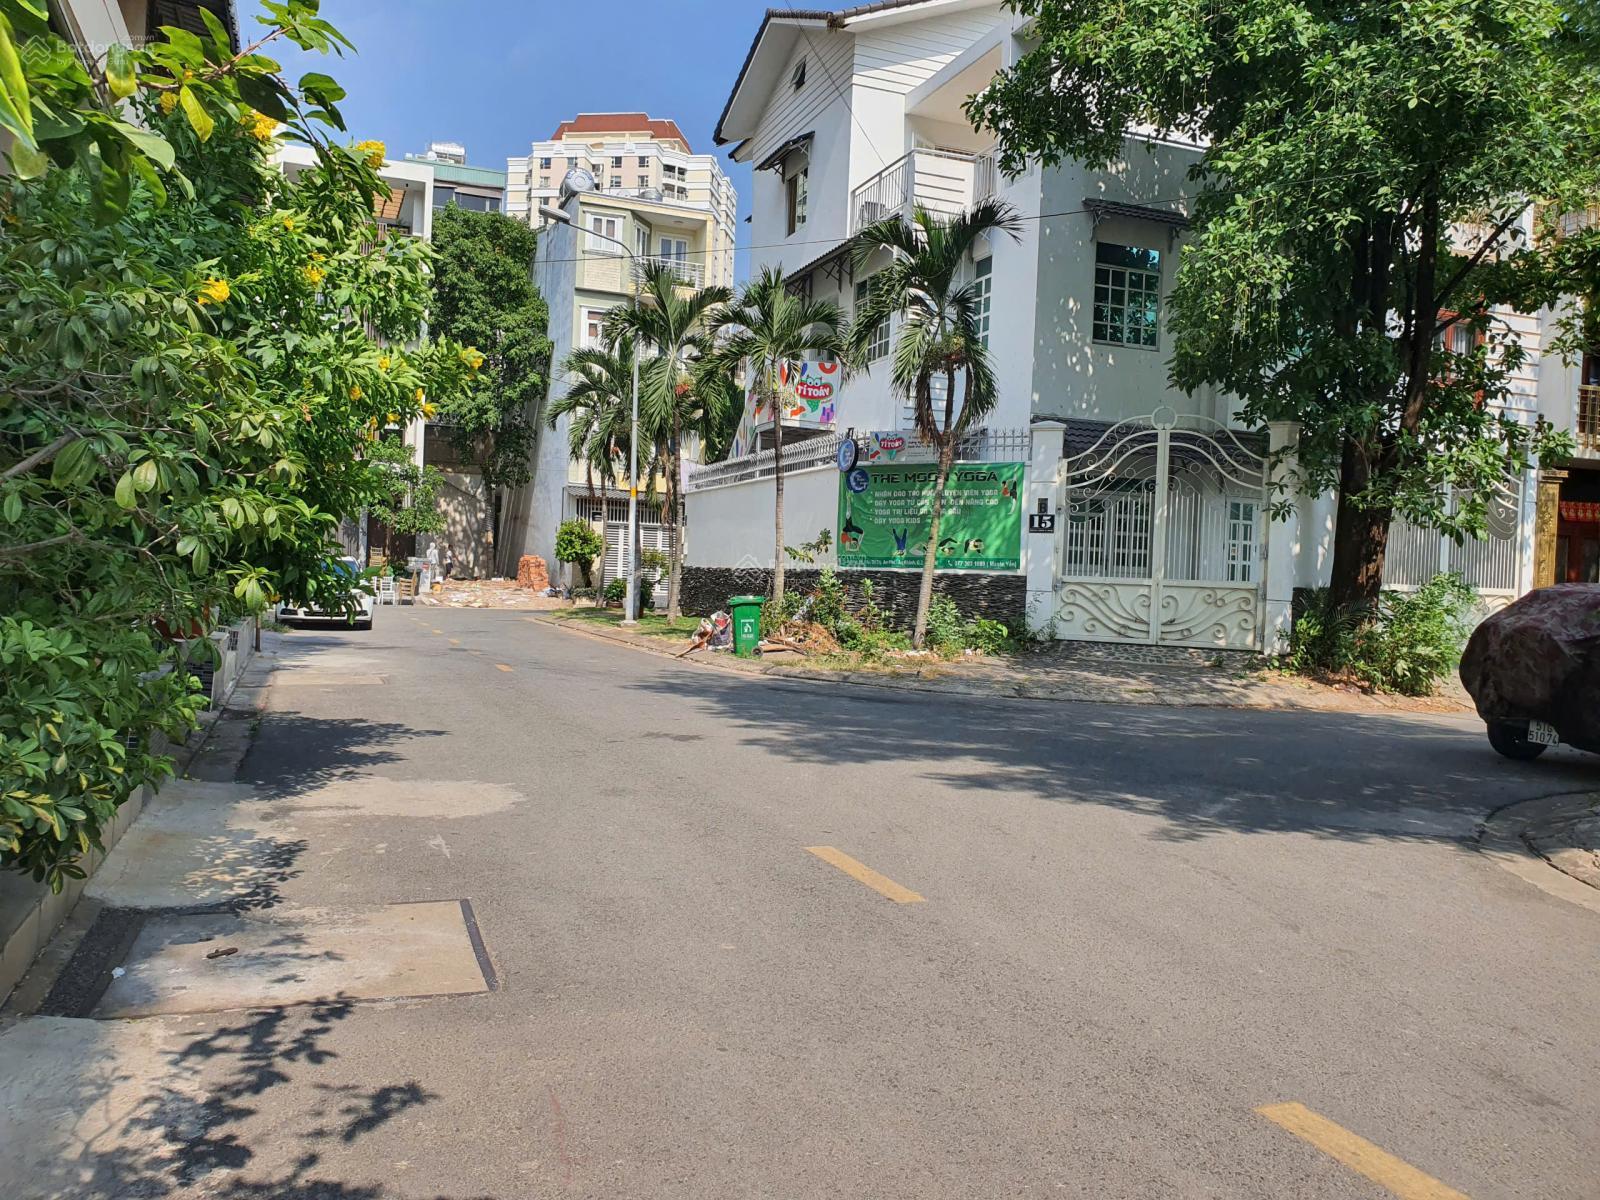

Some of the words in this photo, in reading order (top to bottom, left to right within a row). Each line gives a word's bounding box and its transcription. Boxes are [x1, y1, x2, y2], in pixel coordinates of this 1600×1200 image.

[871, 472, 901, 483] THE
[955, 471, 998, 482] YOGA
[1032, 515, 1052, 528] 15
[1529, 731, 1557, 745] 51074
